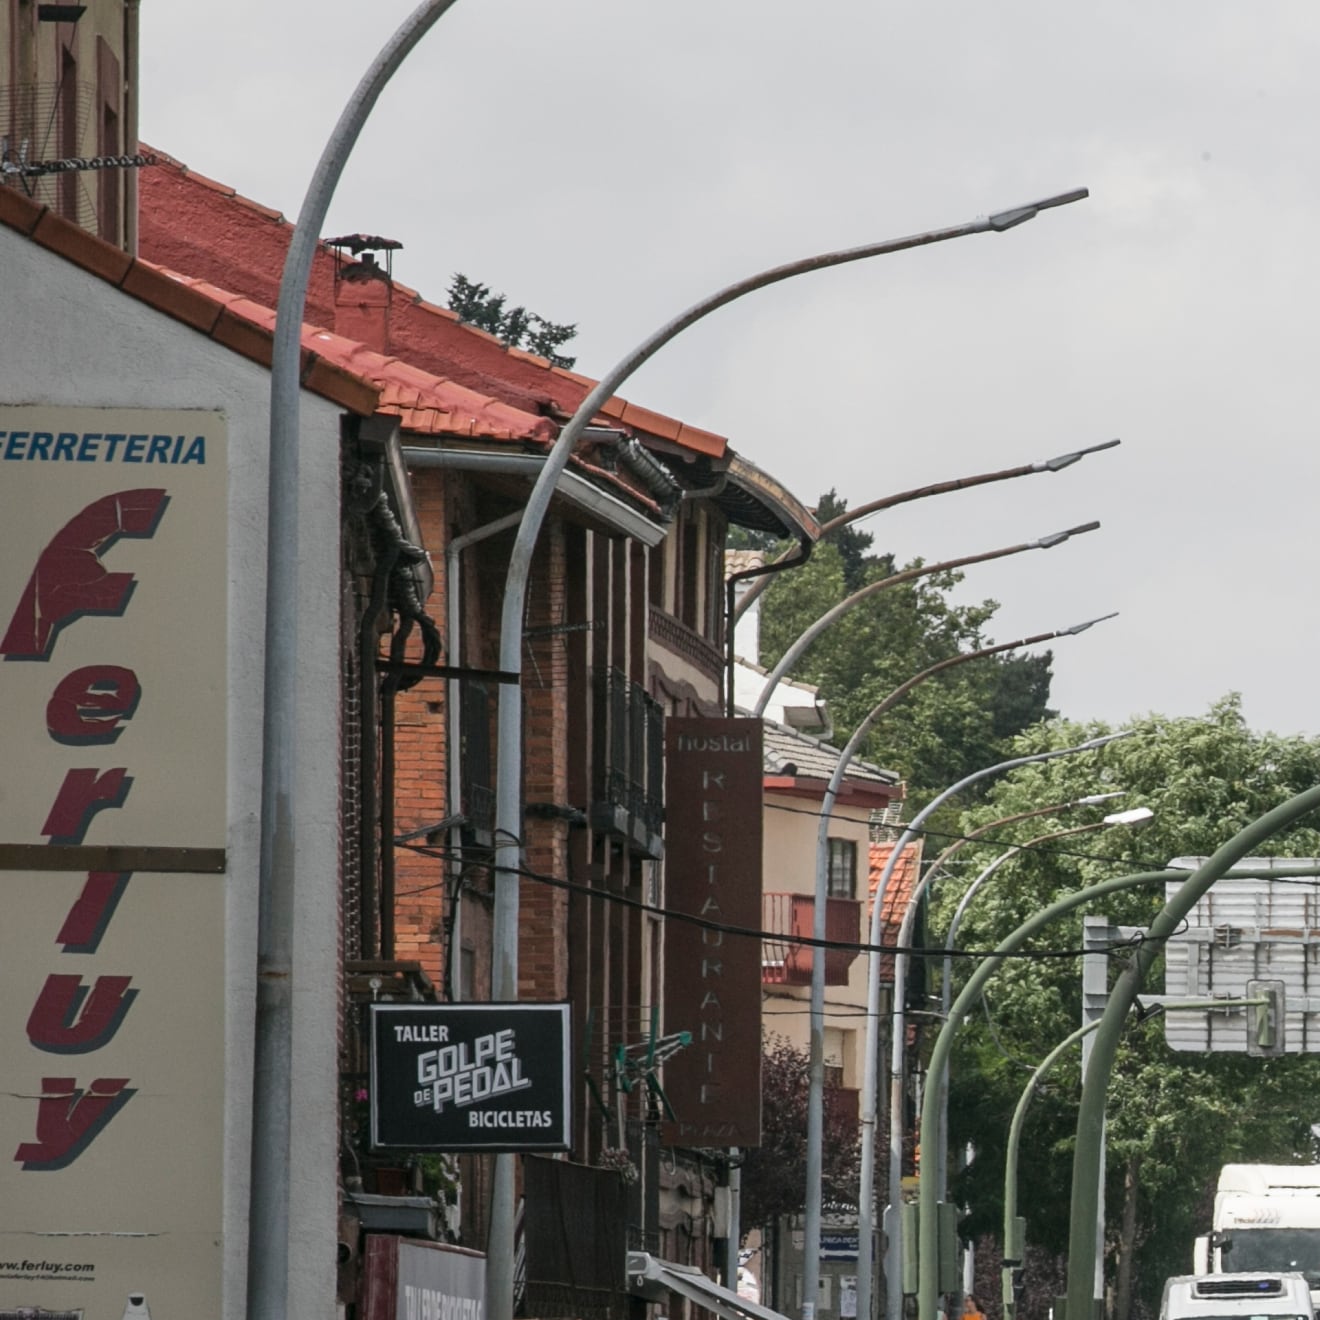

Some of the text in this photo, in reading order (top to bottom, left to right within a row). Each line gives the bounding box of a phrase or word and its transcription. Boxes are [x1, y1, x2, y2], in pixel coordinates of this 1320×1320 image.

[394, 1025, 449, 1042] TALLER
[417, 1028, 516, 1087] GOLPE
[413, 1057, 532, 1114] DE PEDAL
[469, 1110, 553, 1128] BICICLETAS
